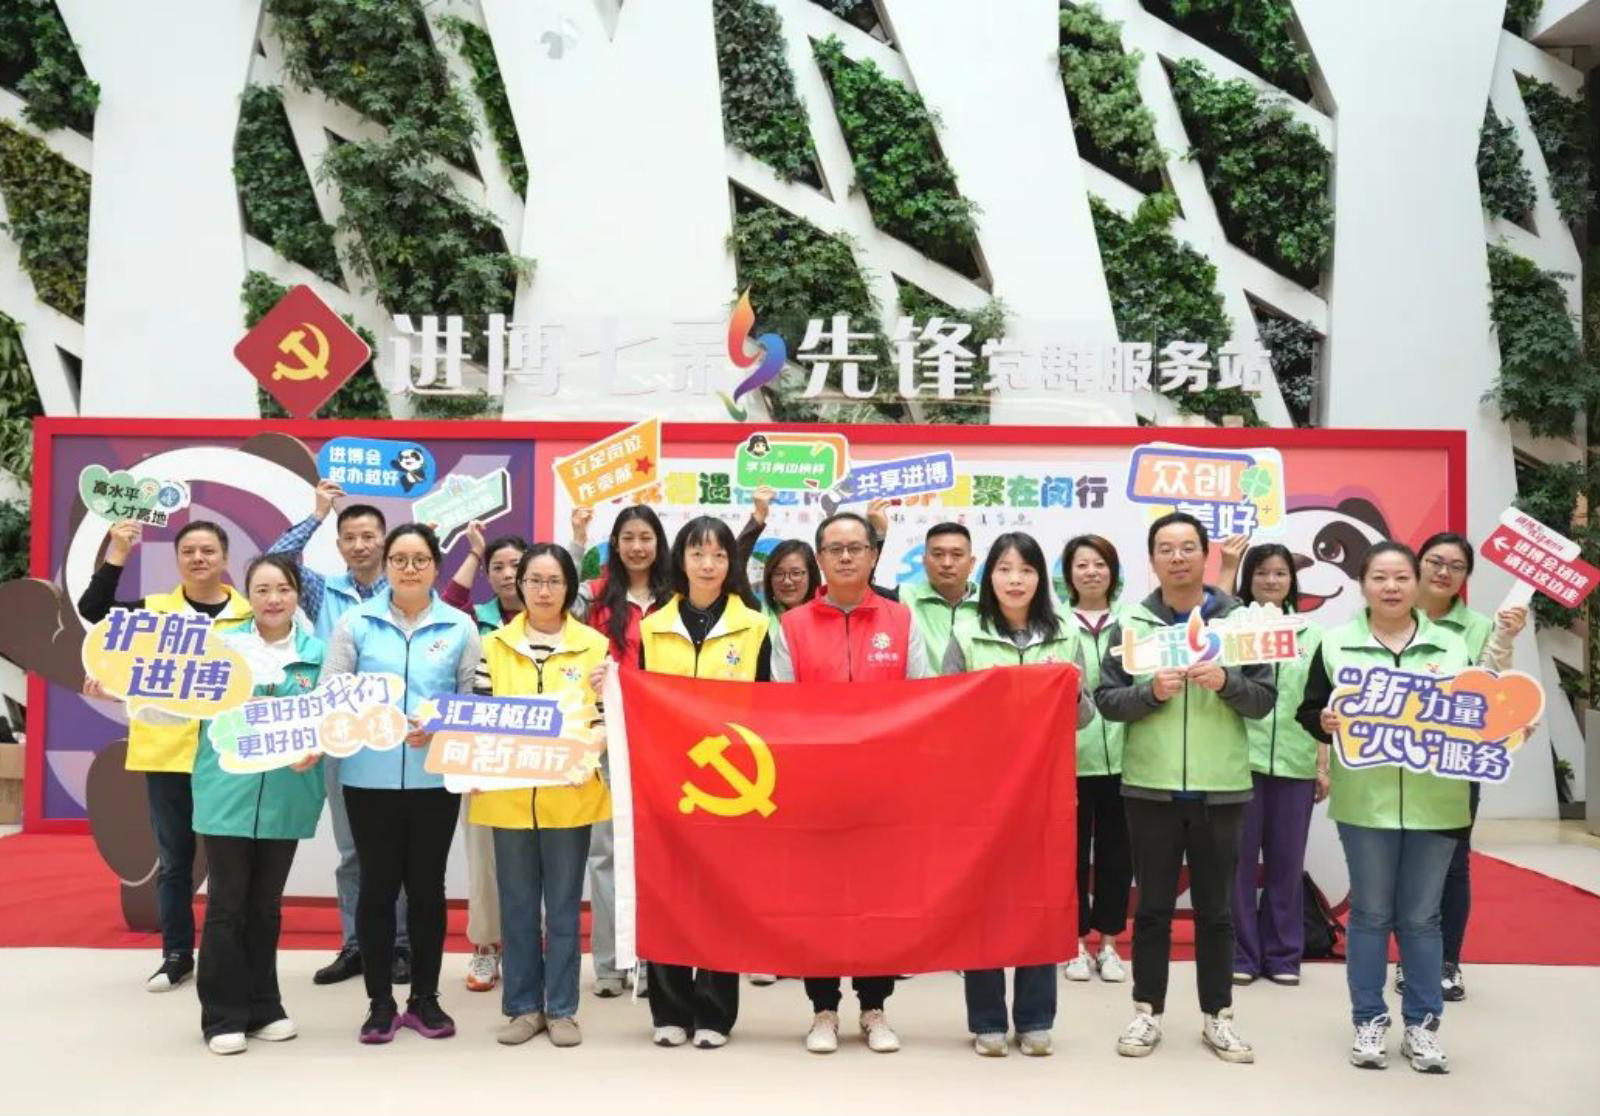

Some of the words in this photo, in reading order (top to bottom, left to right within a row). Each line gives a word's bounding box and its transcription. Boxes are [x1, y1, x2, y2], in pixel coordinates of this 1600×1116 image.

[329, 445, 382, 466] 进博会
[93, 480, 140, 501] 高水平
[329, 466, 399, 487] 越办越好
[857, 460, 948, 497] 共享进博
[1152, 461, 1232, 498] 众创
[105, 502, 167, 524] 人才高地
[104, 610, 211, 656] 护航
[127, 657, 231, 701] 进博
[244, 675, 390, 727] 更好的我们
[443, 699, 555, 731] 汇聚枢纽
[441, 735, 571, 774] 向新而行
